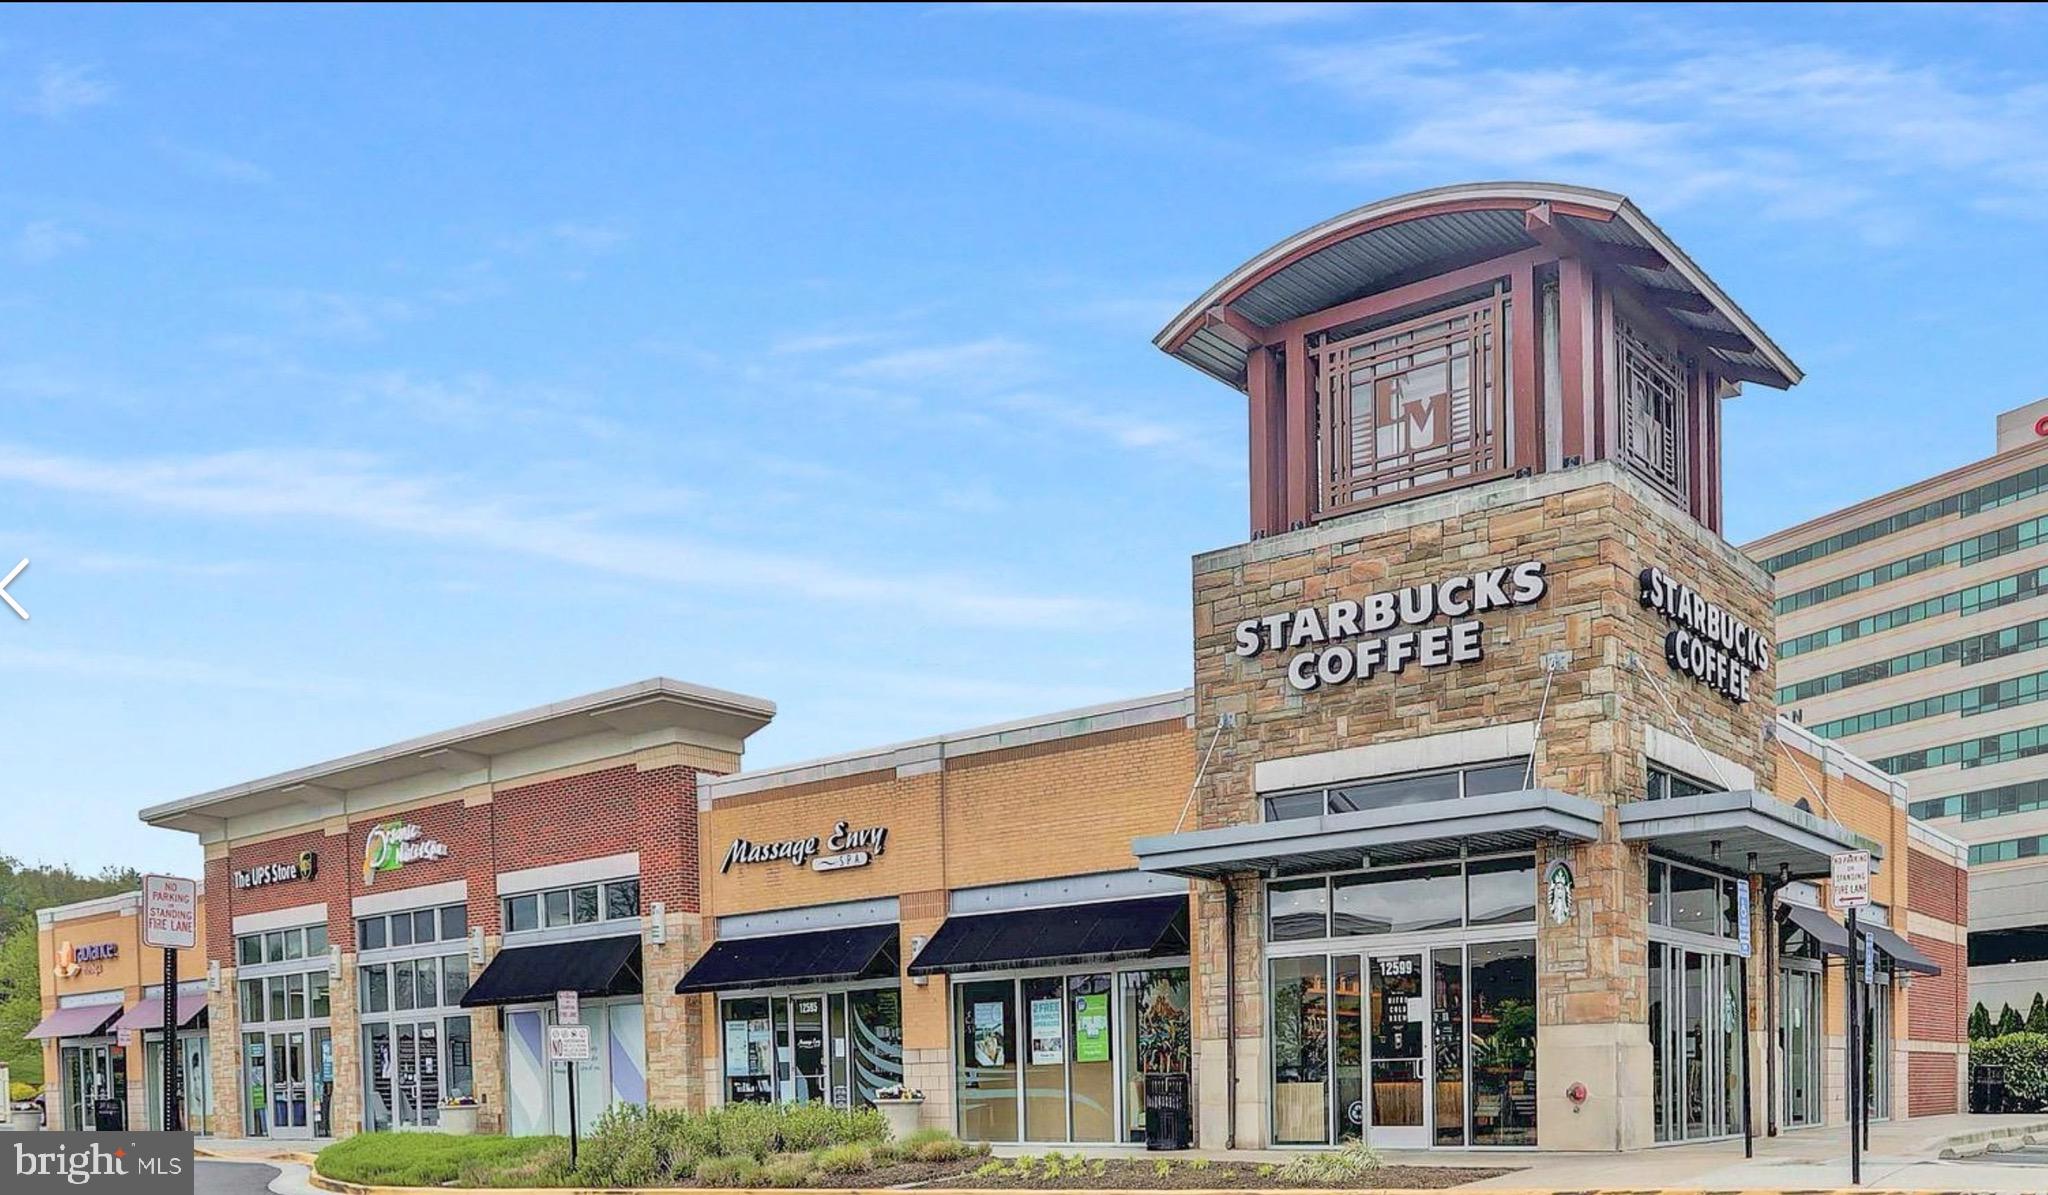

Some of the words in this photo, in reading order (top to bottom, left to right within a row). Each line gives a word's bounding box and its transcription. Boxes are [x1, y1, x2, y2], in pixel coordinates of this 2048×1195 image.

[1236, 562, 1546, 657] STARBUCKS
[1644, 566, 1769, 671] STARBUCKS
[1288, 621, 1483, 690] COFFEE
[1669, 630, 1751, 702] COFFEE
[720, 837, 819, 874] Massage
[827, 820, 887, 855] Envy
[839, 855, 861, 867] SPA
[234, 870, 251, 888] The
[251, 865, 270, 886] UPS
[271, 862, 297, 883] Store
[152, 891, 190, 904] PARKING
[164, 882, 178, 892] NO
[149, 907, 193, 920] STANDING
[148, 918, 167, 930] FIRE
[170, 920, 193, 933] LANE
[1380, 960, 1412, 976] 12599
